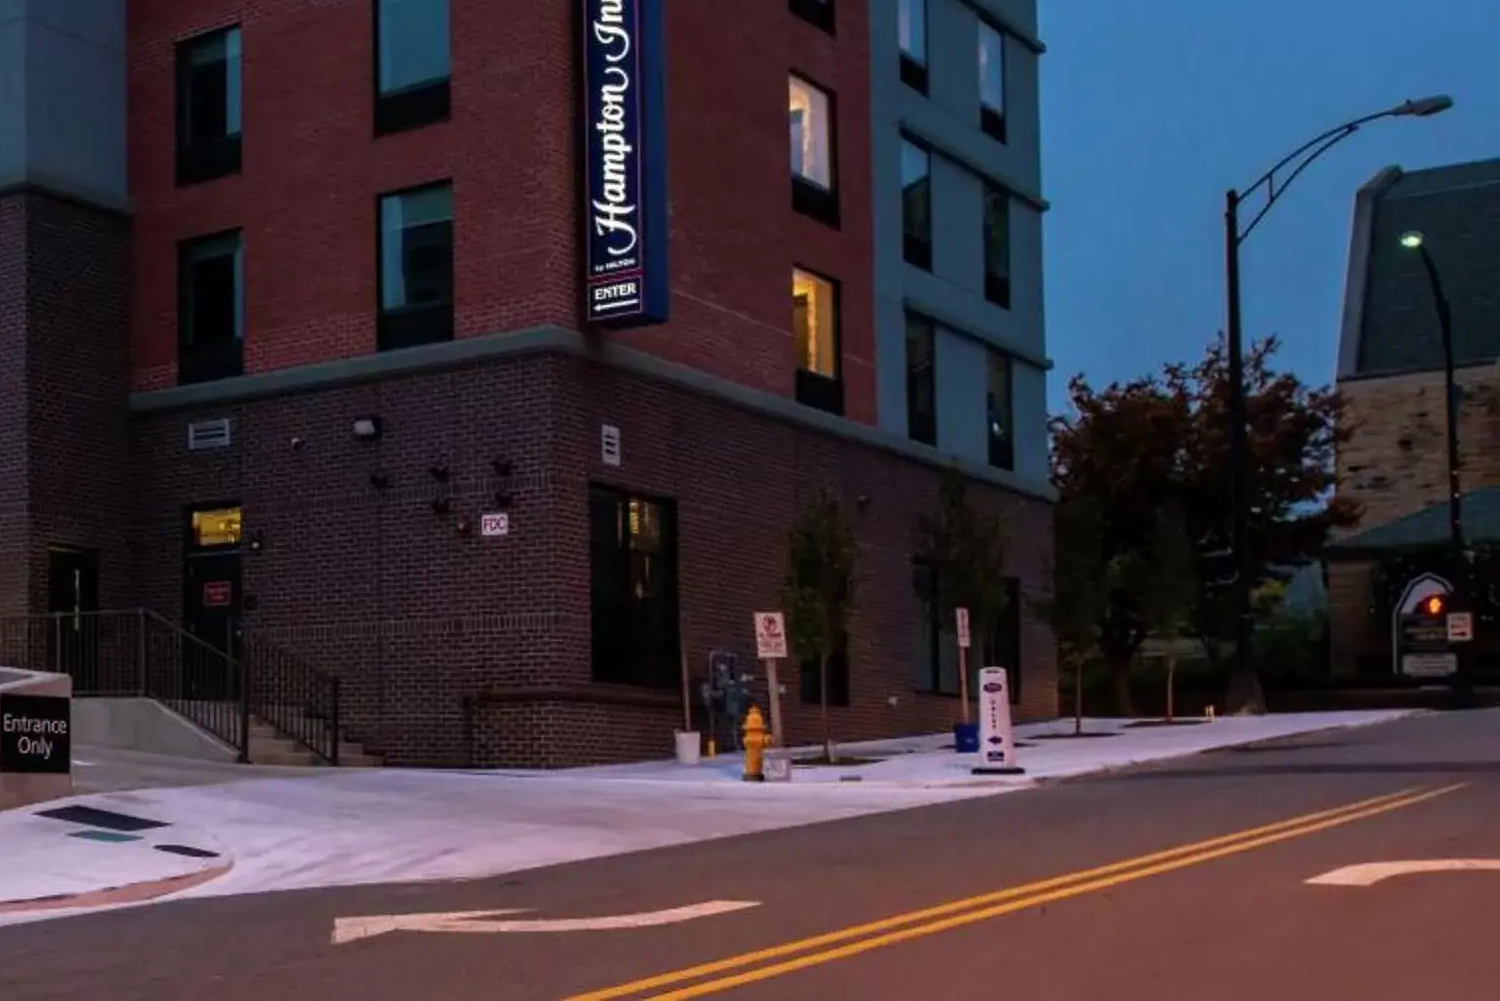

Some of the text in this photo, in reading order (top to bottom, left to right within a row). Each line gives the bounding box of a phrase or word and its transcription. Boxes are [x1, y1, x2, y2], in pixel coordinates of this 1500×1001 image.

[591, 66, 637, 256] Hampton
[595, 282, 637, 300] ENTER
[483, 516, 506, 532] FDC
[3, 713, 67, 734] Entrance
[17, 735, 53, 760] Only
